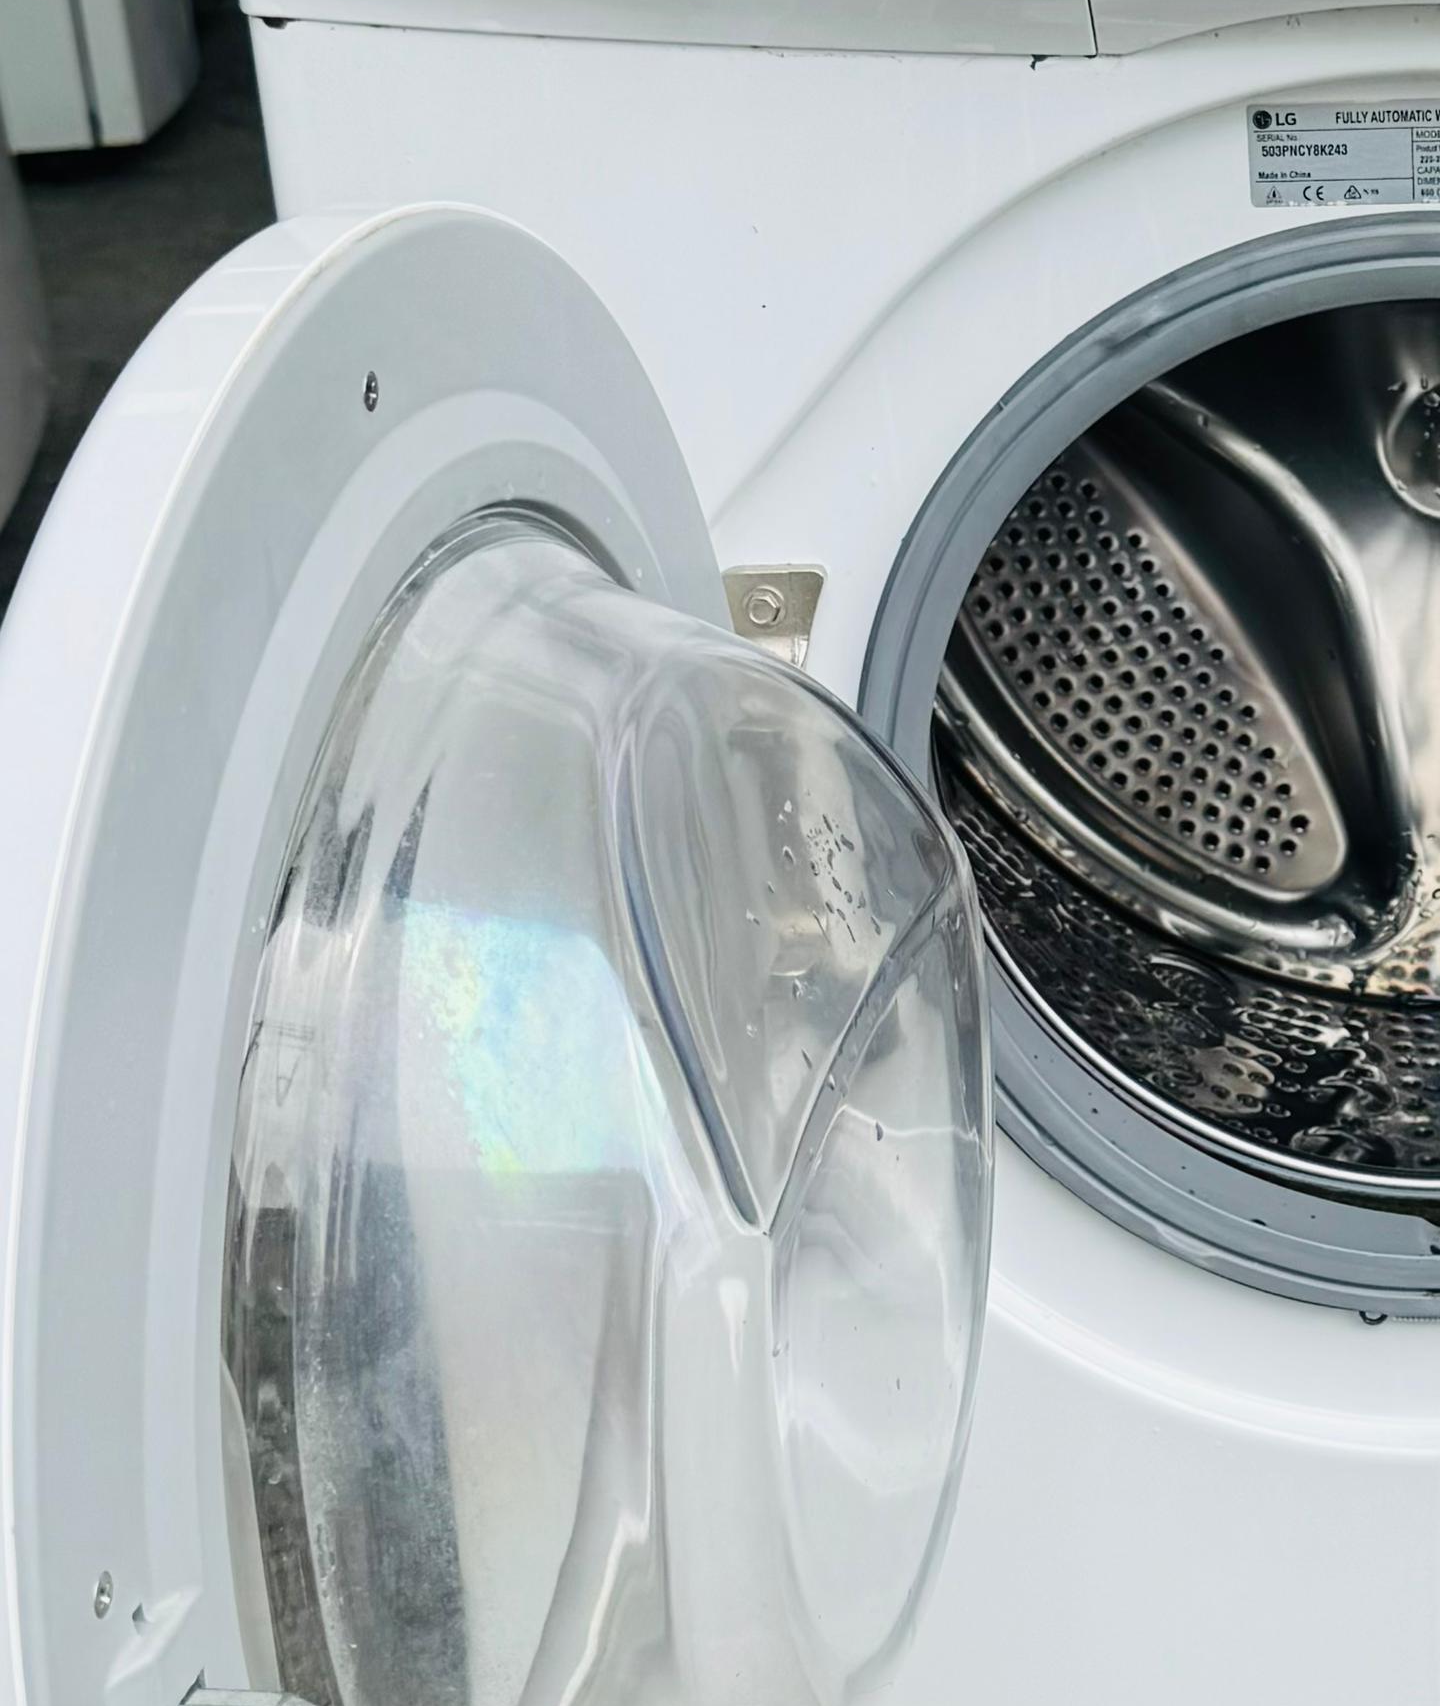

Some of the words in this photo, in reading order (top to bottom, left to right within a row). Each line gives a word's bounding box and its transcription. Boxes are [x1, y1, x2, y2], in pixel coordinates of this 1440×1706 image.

[1276, 113, 1296, 125] LG
[1336, 112, 1368, 123] FULLY
[1371, 109, 1431, 123] AUTOMATIC
